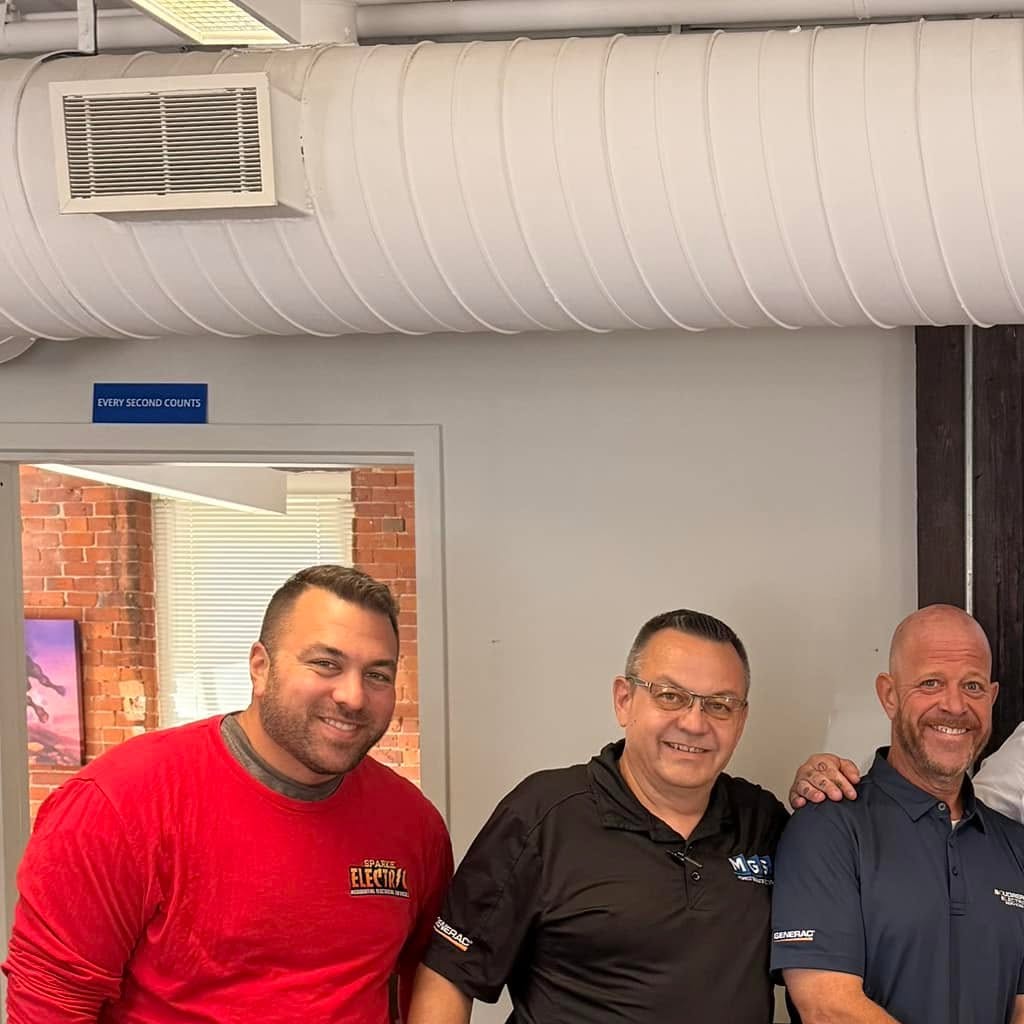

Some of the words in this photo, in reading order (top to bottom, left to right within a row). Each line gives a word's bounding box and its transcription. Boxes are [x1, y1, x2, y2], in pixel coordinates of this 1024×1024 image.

[98, 398, 124, 407] EVERY
[126, 398, 162, 408] SECOND
[164, 398, 201, 408] COUNTS
[773, 930, 816, 940] GENERAC
